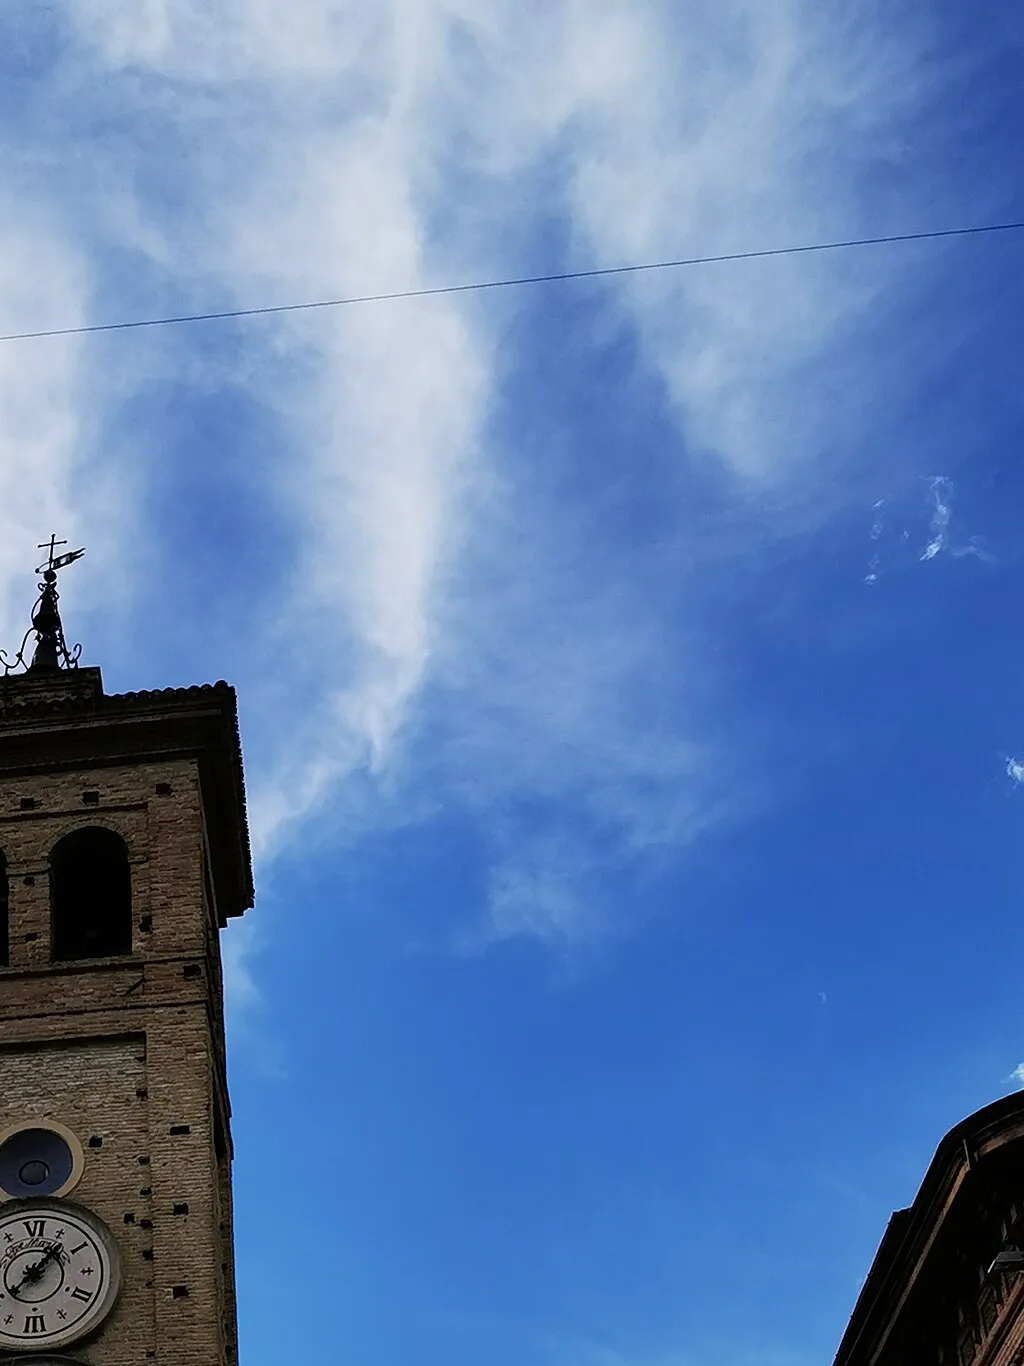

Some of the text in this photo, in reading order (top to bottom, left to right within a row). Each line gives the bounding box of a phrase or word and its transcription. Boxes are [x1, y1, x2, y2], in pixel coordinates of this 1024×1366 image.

[22, 1220, 47, 1237] VI
[70, 1241, 89, 1255] I
[71, 1286, 94, 1303] II
[23, 1315, 47, 1333] III
